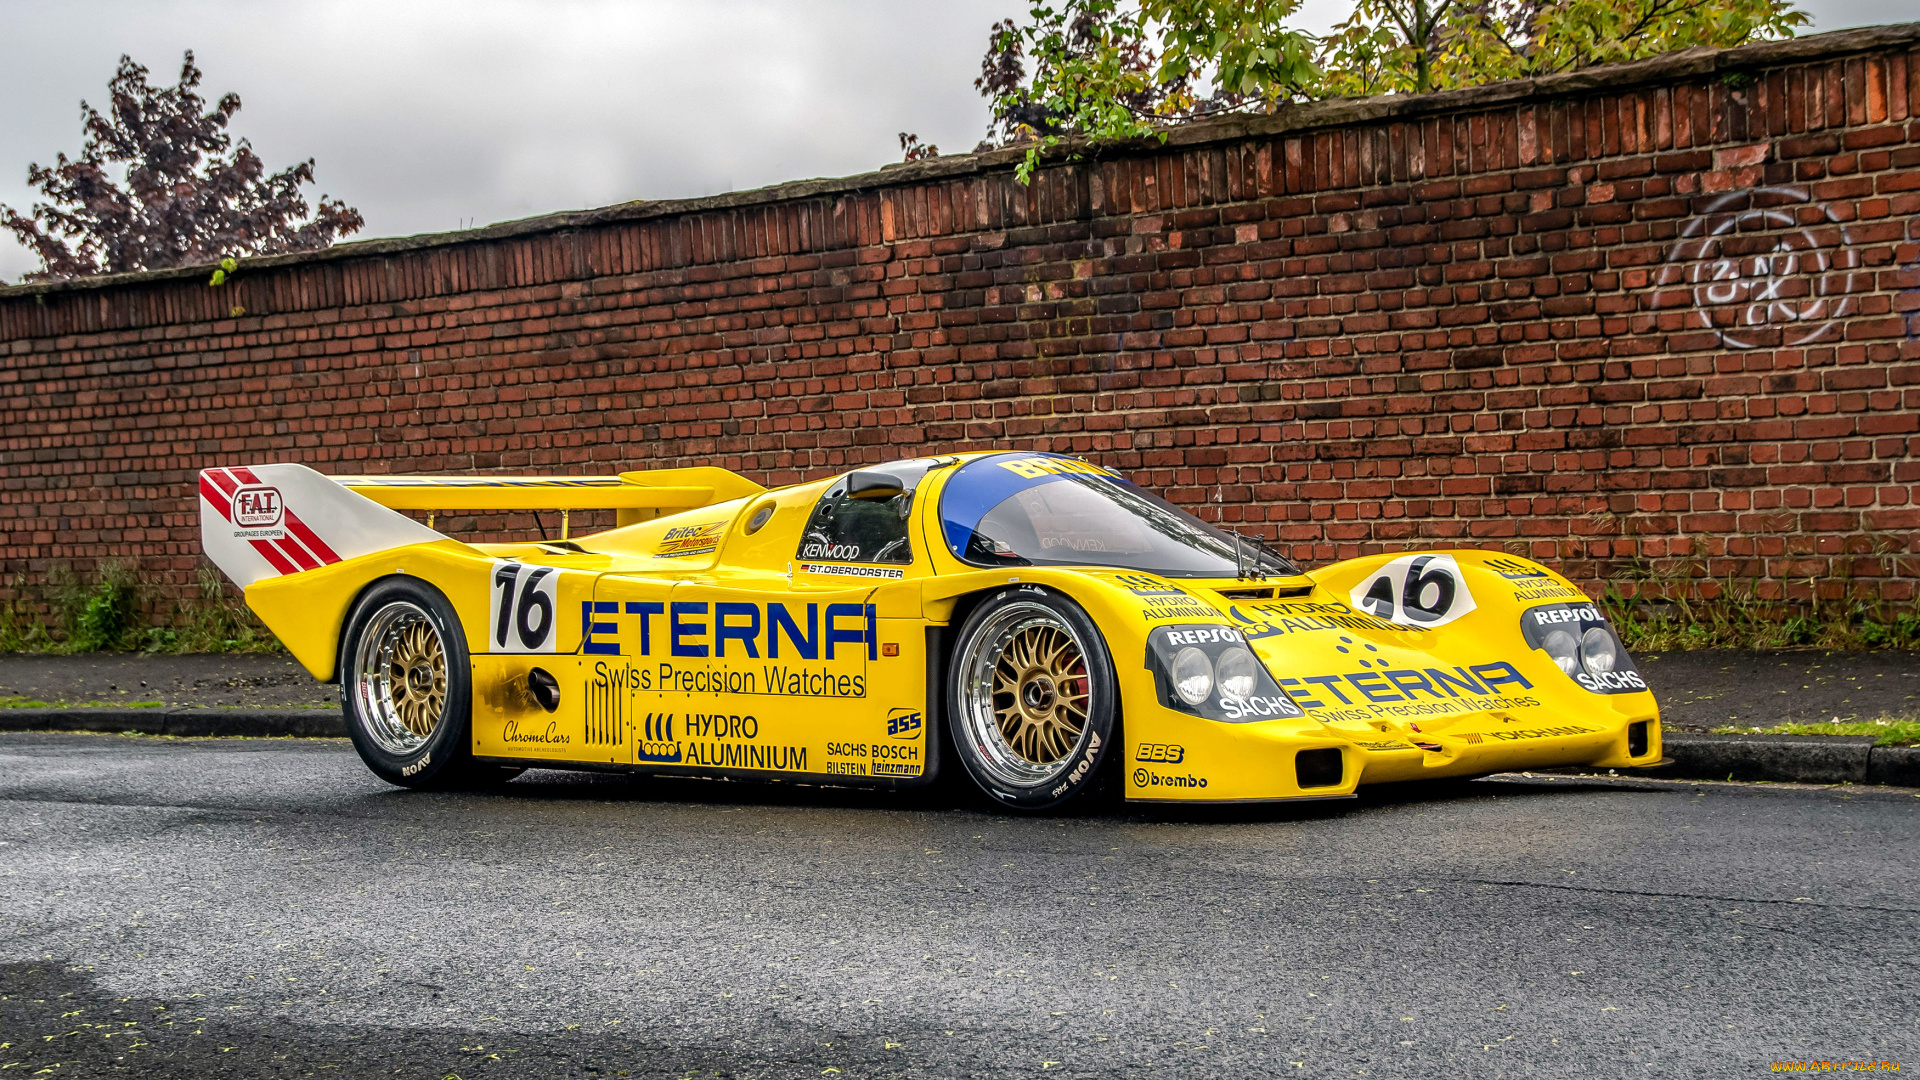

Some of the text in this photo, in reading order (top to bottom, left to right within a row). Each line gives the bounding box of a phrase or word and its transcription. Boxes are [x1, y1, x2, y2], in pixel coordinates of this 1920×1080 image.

[233, 530, 259, 538] GROUPAGES
[662, 526, 702, 540] Britec
[680, 535, 721, 548] Motorsports
[802, 543, 860, 560] KENWOOD
[1362, 555, 1456, 623] 16
[1513, 578, 1561, 589] HYDRO
[1143, 596, 1199, 607] HYDRO
[1513, 587, 1583, 602] ALUMINIUM
[495, 563, 554, 650] 16
[1142, 606, 1223, 621] ALUMINIUM
[1250, 602, 1352, 616] HYDRO
[1280, 615, 1432, 633] ALUMINIUM
[1533, 608, 1605, 626] REPSOL
[580, 600, 878, 661] ETERNA
[1166, 627, 1248, 646] REPSOL
[594, 661, 865, 696] Swiss Precision Watches
[1279, 661, 1534, 709] ETERNA
[1576, 669, 1646, 692] SACHS
[1219, 696, 1300, 719] SACHS
[1308, 694, 1542, 724] Swiss Precision Watches
[503, 720, 570, 744] ChromeCars
[685, 713, 759, 739] HYDRO
[1481, 726, 1597, 741] YOKOHAMA
[685, 742, 807, 770] ALUMINIUM
[826, 742, 918, 760] SACHS BOSCH
[1068, 731, 1102, 785] AVON
[1135, 743, 1185, 764] BBS
[402, 751, 431, 777] AVON
[826, 758, 921, 775] BILSTEIN heinzmann
[1151, 771, 1208, 788] brembo
